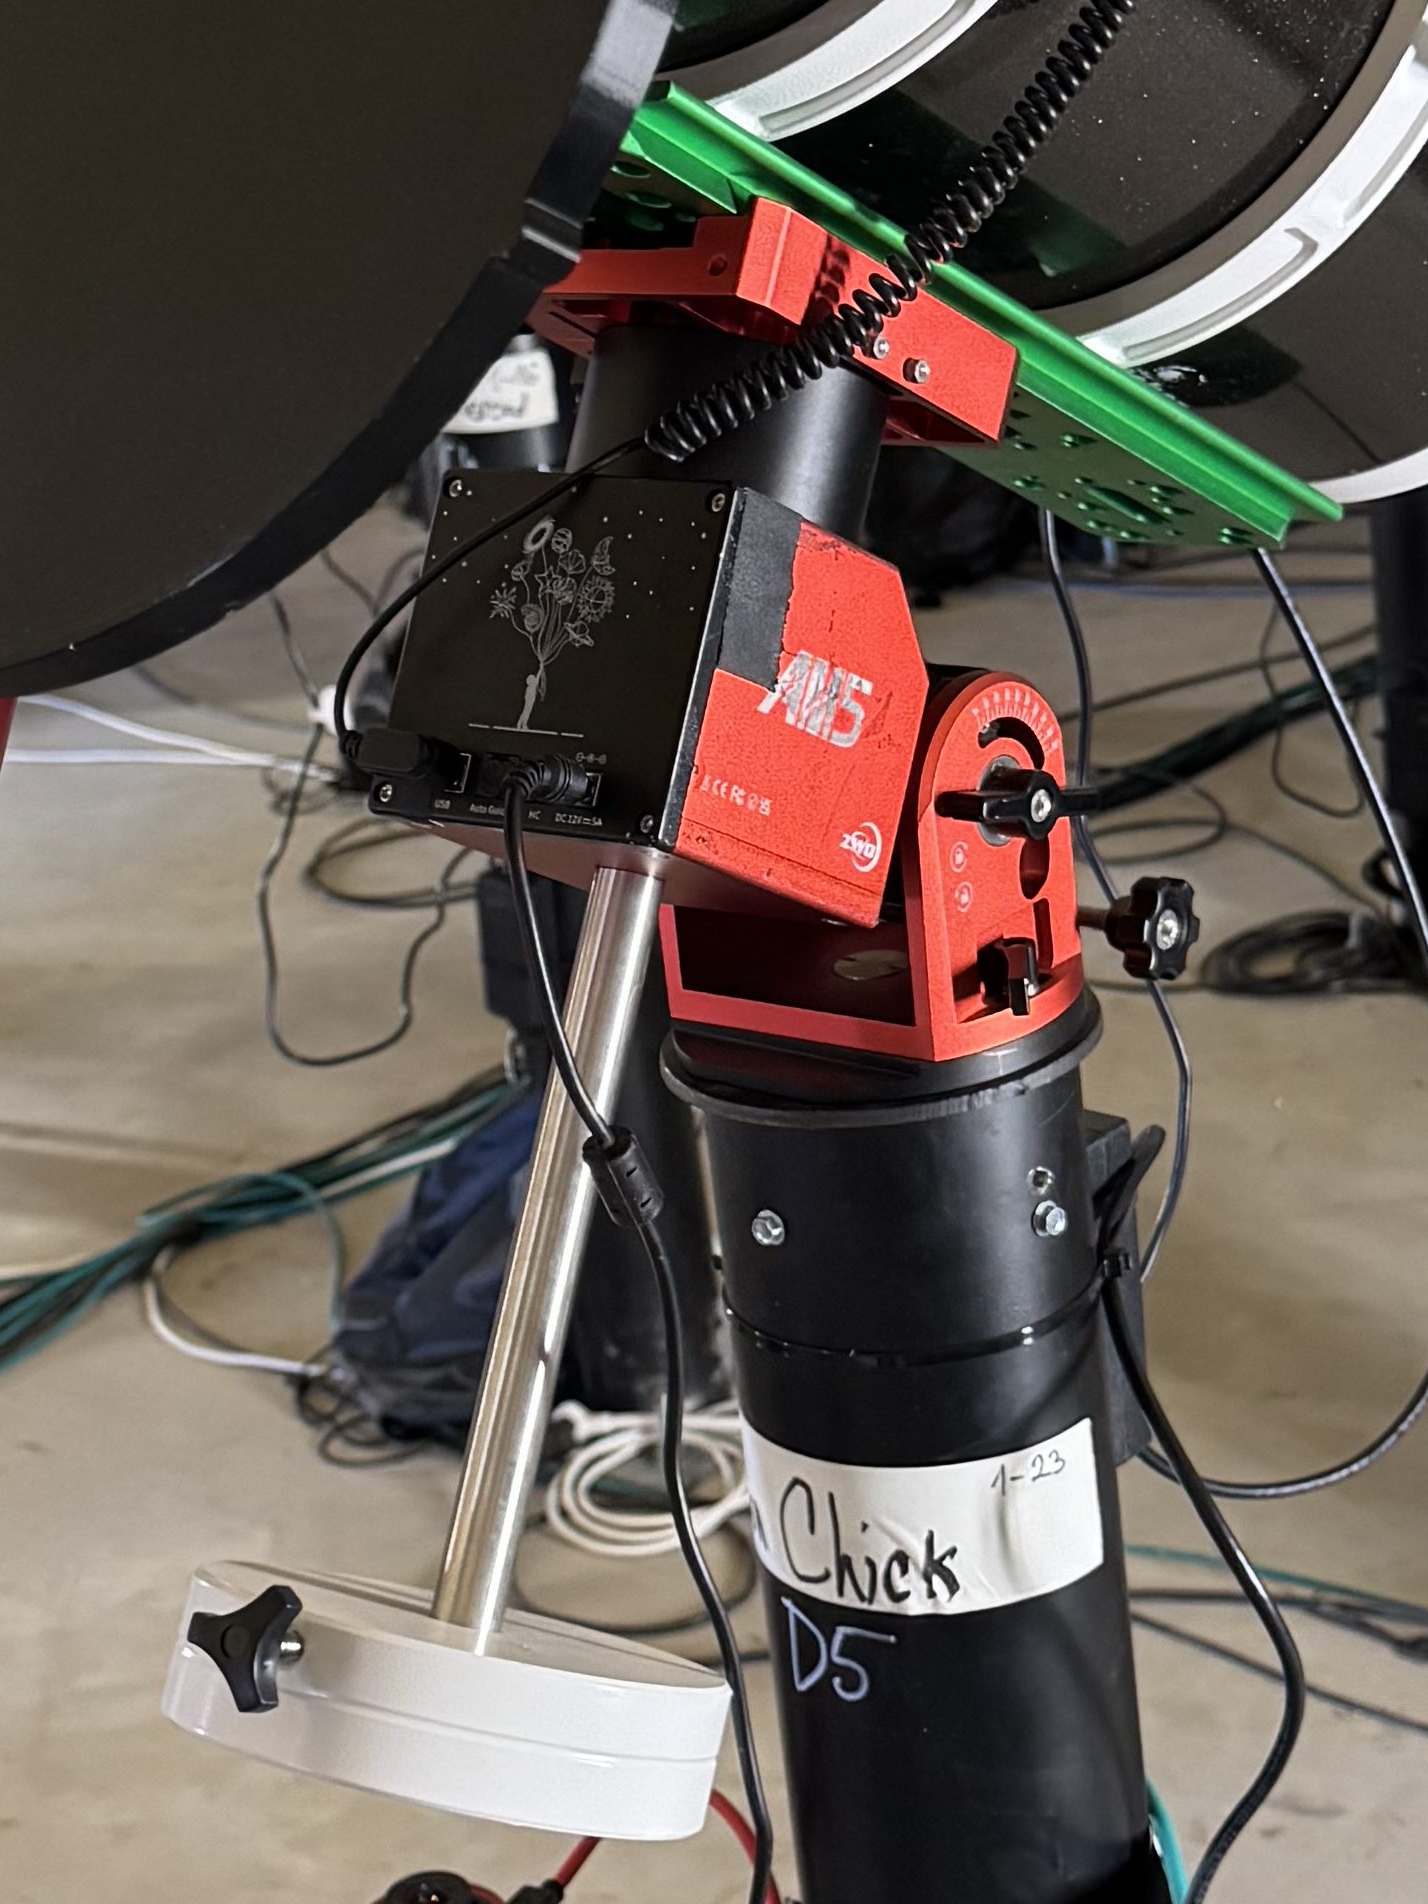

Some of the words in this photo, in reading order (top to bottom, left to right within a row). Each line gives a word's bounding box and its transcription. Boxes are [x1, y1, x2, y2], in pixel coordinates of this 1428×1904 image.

[756, 649, 874, 749] AM5
[991, 1449, 1066, 1497] 1-23
[779, 1476, 961, 1606] Chick
[782, 1596, 897, 1702] D5
